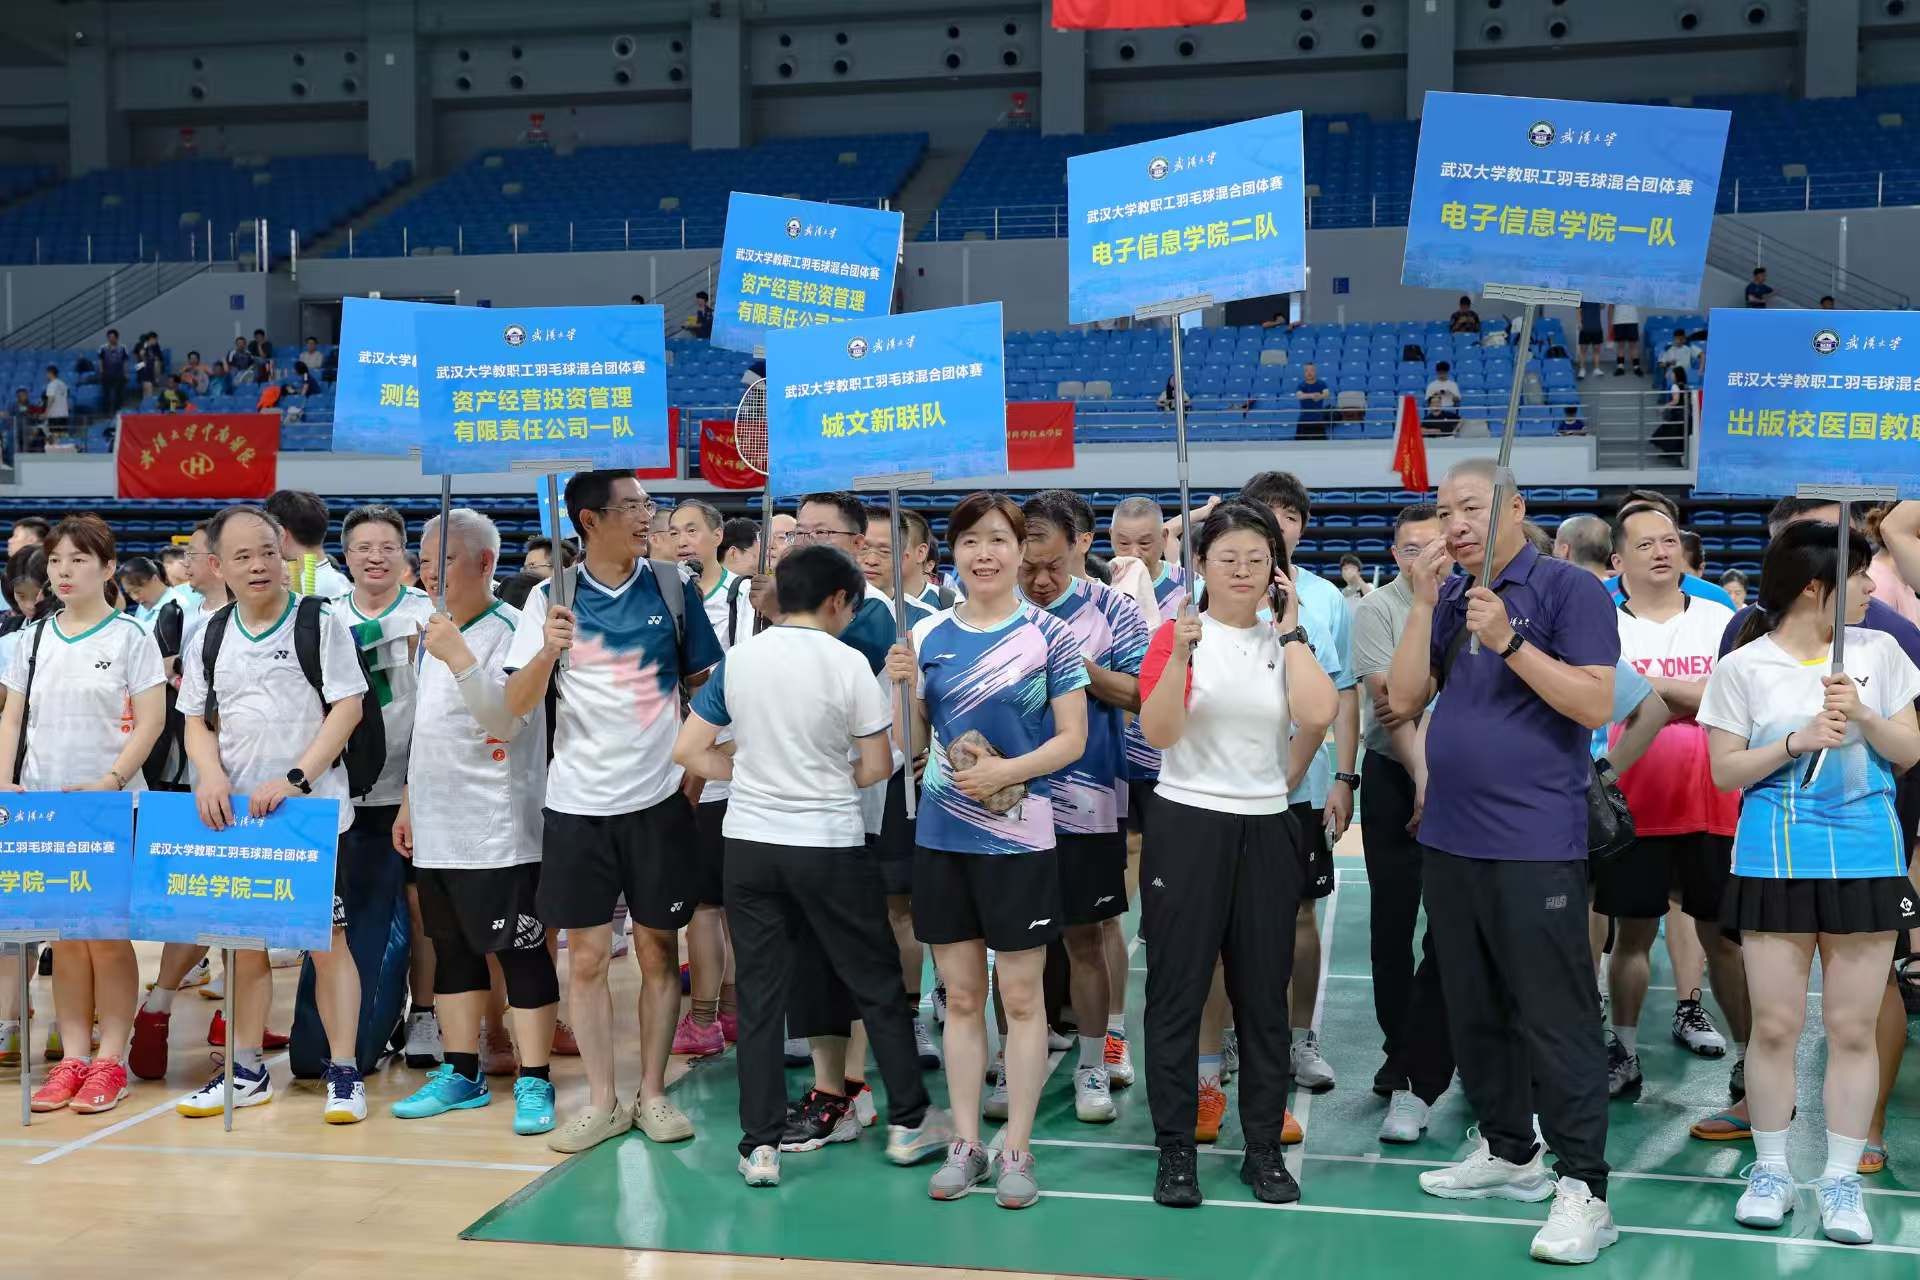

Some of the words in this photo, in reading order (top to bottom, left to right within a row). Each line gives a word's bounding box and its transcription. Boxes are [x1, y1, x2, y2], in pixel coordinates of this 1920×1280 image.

[1440, 161, 1695, 196] 武汉大学教职工羽毛球混合团体赛
[1086, 175, 1284, 224] 武汉大学教职工羽毛球混合团体赛
[1091, 211, 1280, 267] 电子信息学院二队
[1440, 200, 1677, 248] 电子信息学院一队
[735, 248, 881, 281] 武汉大学教职工羽毛球混合团体赛
[740, 272, 866, 312] 资产经营投资管理
[435, 360, 646, 380] 武汉大学教职工羽毛球混合团体赛
[783, 362, 985, 399] 武汉大学教职工羽毛球混合团体赛
[451, 386, 634, 413] 资产经营投资管理
[453, 415, 635, 444] 有限责任公司一队
[820, 400, 947, 439] 城文新联队
[1656, 655, 1713, 677] YONEX
[149, 842, 320, 863] 武汉大学教职工羽毛球混合团体赛
[0, 869, 93, 894] 学院一队
[167, 871, 296, 902] 测绘学院二队
